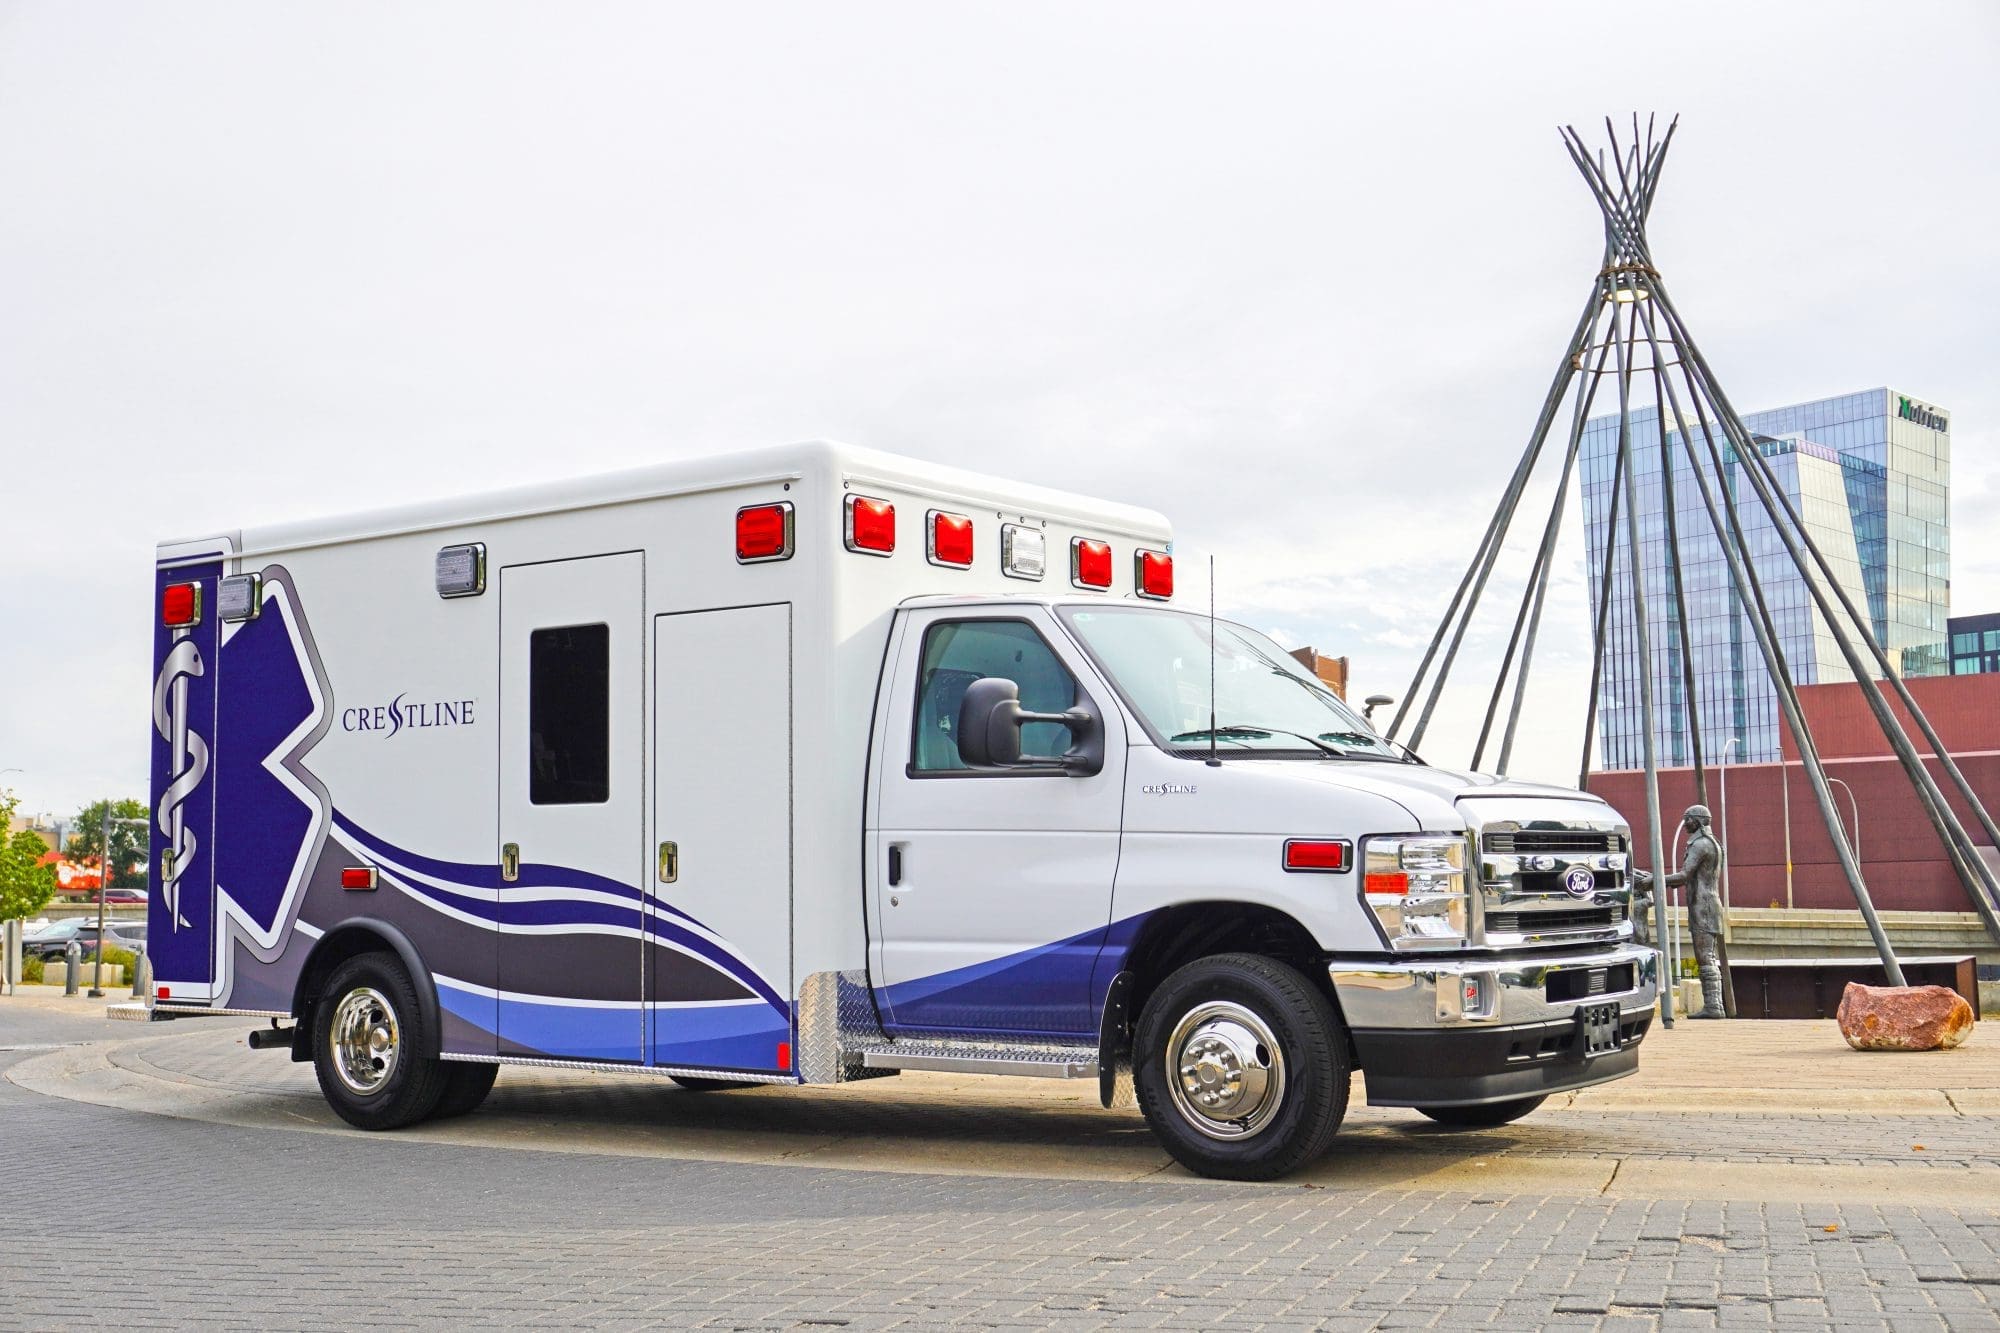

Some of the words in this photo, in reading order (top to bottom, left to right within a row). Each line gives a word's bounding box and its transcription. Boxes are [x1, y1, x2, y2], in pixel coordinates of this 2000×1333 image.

[1898, 396, 1947, 432] Nutrien
[342, 691, 475, 740] CRESTLINE
[1142, 782, 1198, 797] CRESTLINE
[1571, 872, 1590, 891] Ford
